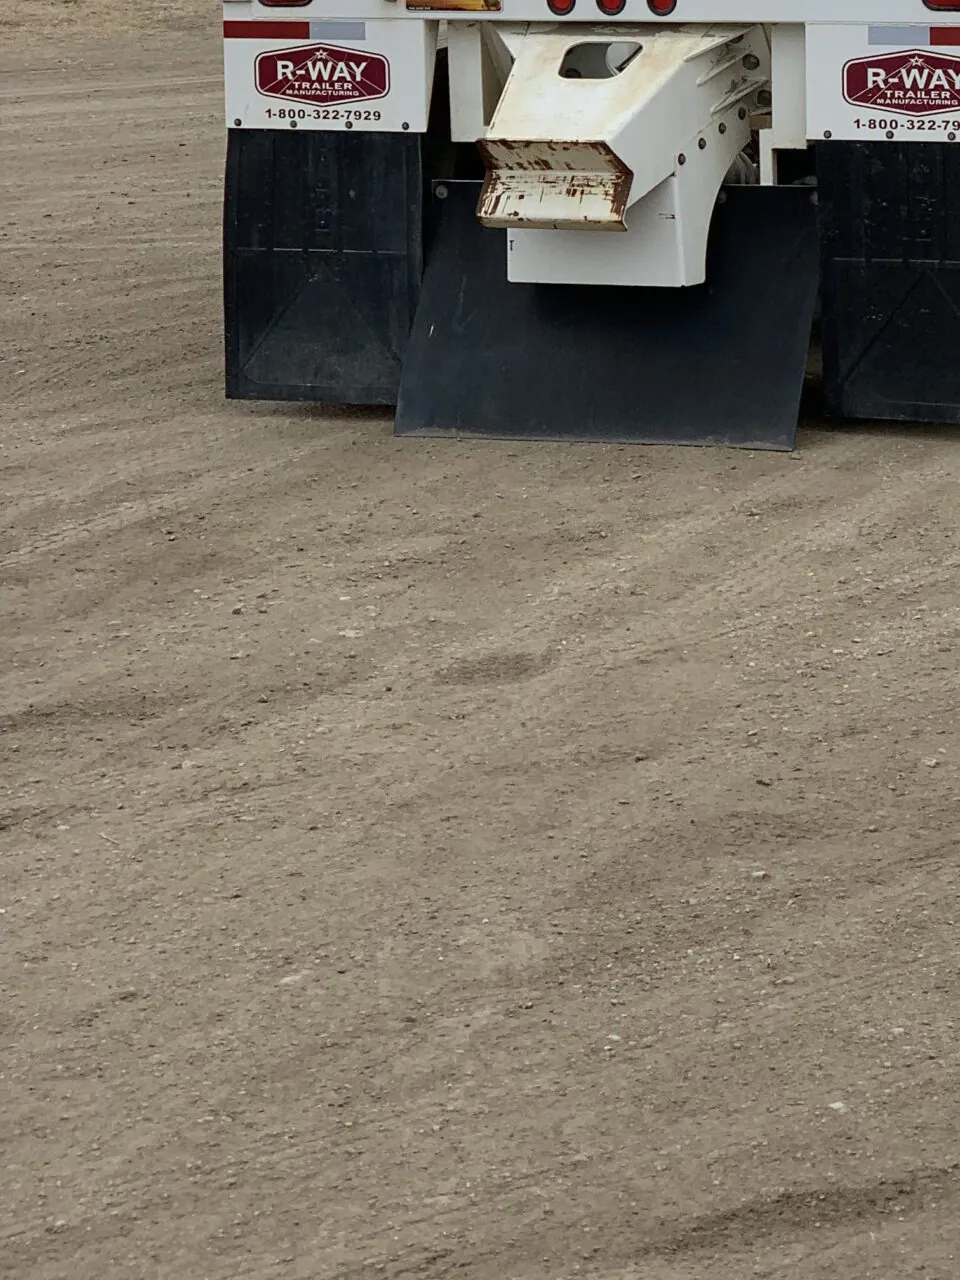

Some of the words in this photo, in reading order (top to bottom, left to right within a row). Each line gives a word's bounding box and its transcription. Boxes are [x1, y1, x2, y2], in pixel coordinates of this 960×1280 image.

[276, 60, 368, 81] R-WAY
[293, 82, 353, 90] TRAILER
[285, 89, 360, 97] MANUFACTURING
[884, 90, 951, 99] TRAILER
[876, 98, 959, 106] MANUFACTURING
[265, 108, 382, 121] 1-800-322-7929
